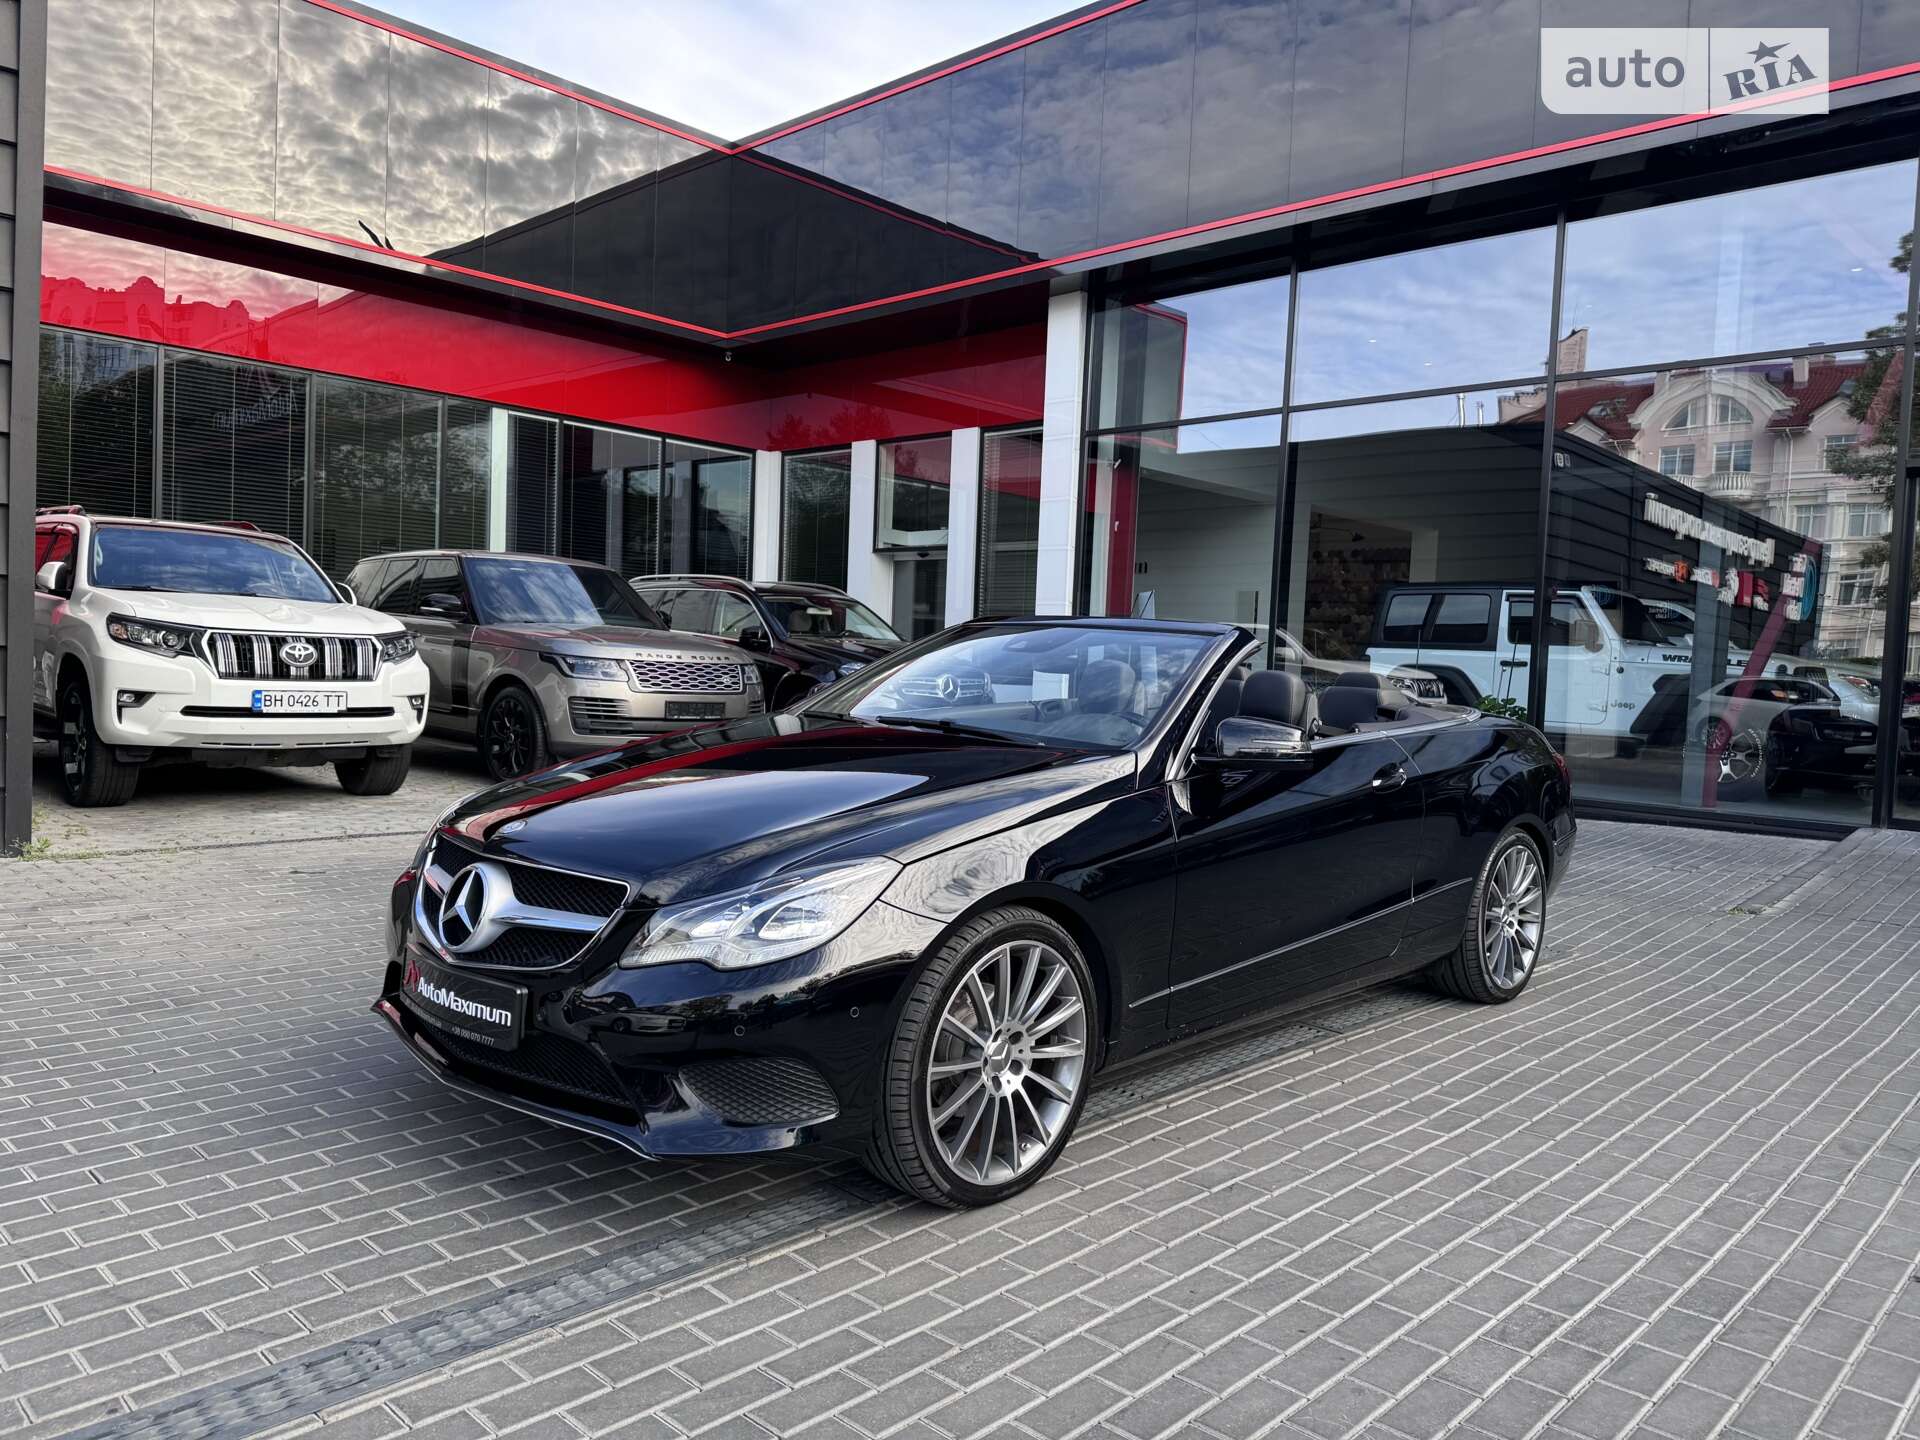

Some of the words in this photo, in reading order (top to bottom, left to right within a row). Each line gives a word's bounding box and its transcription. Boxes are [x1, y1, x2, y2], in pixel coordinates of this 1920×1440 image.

[635, 652, 683, 660] RANGE
[264, 694, 283, 707] BH
[287, 694, 319, 707] 0426
[323, 694, 344, 707] TT
[1611, 699, 1635, 710] Jeep
[418, 977, 512, 1027] AutoMaximum
